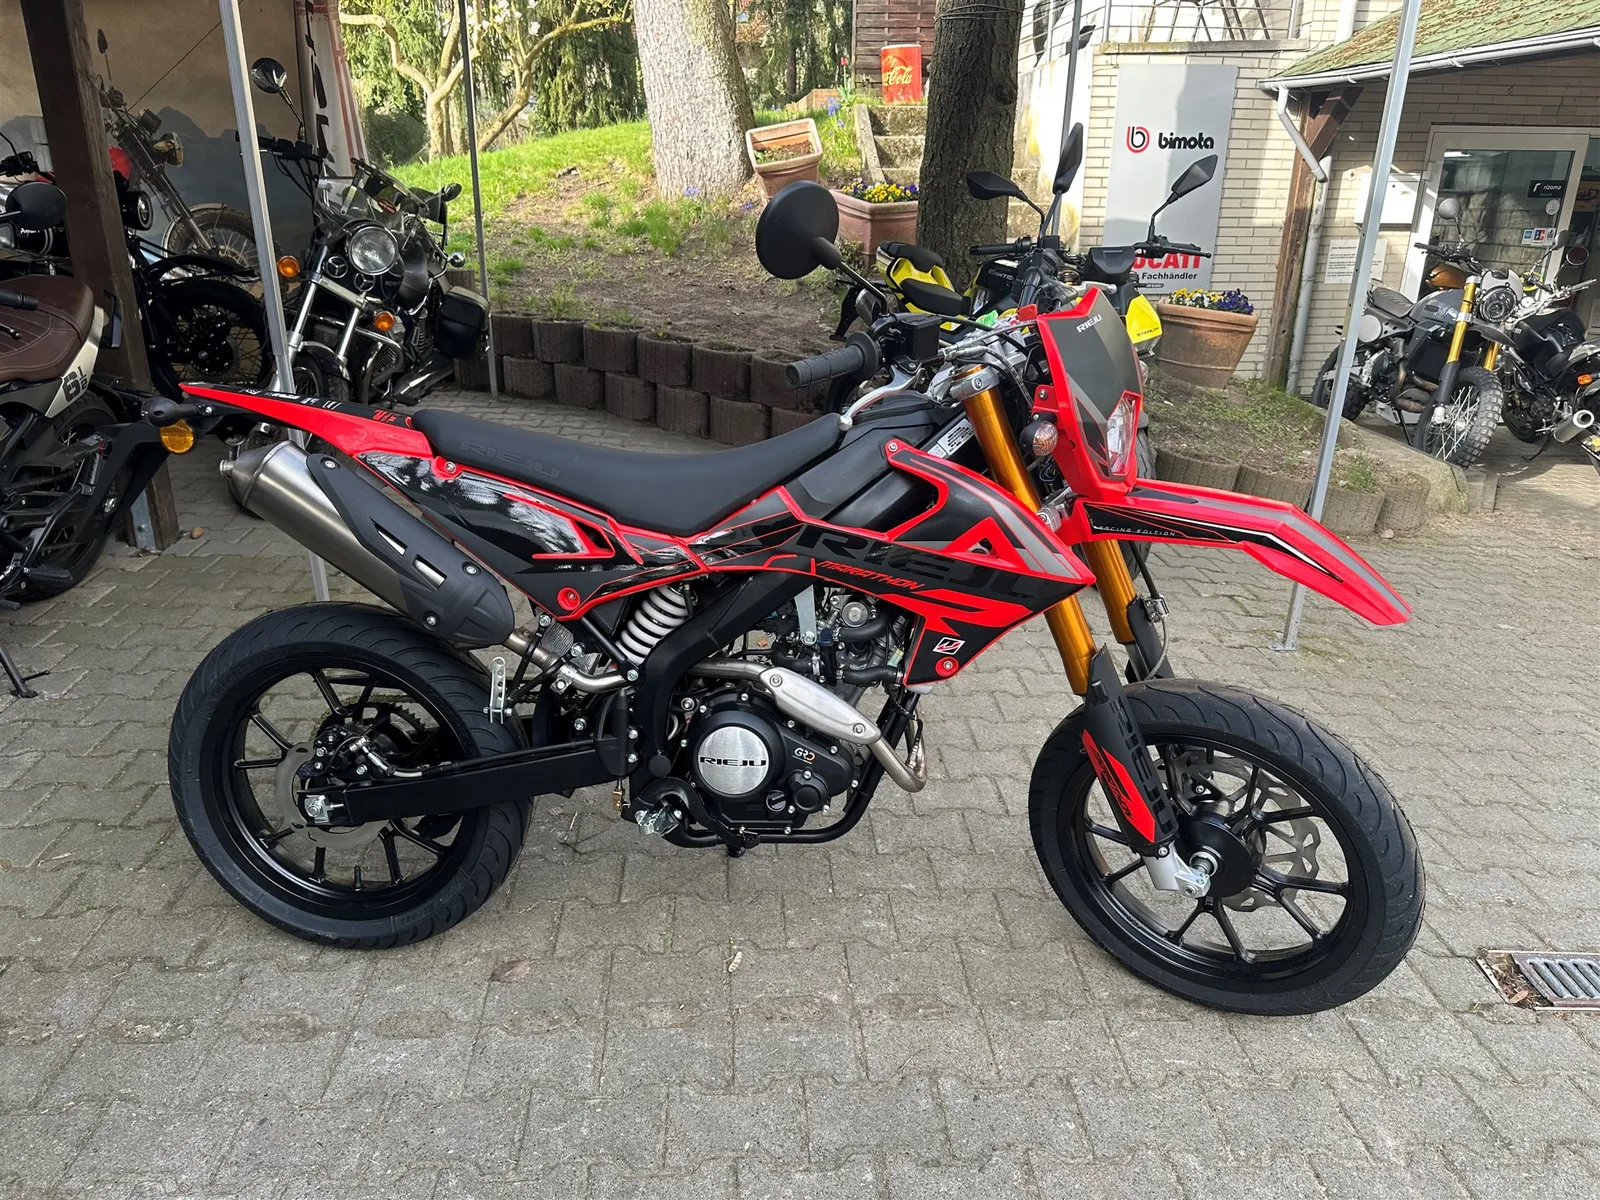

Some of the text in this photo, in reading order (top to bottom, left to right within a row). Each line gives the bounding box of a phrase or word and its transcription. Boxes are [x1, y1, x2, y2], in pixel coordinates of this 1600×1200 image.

[1158, 132, 1215, 149] bimota
[1076, 314, 1102, 333] RIEJU
[1136, 529, 1176, 537] EDITION
[796, 523, 1044, 600] RIEJU
[816, 560, 926, 591] MARATHON
[699, 756, 767, 767] RIEJU
